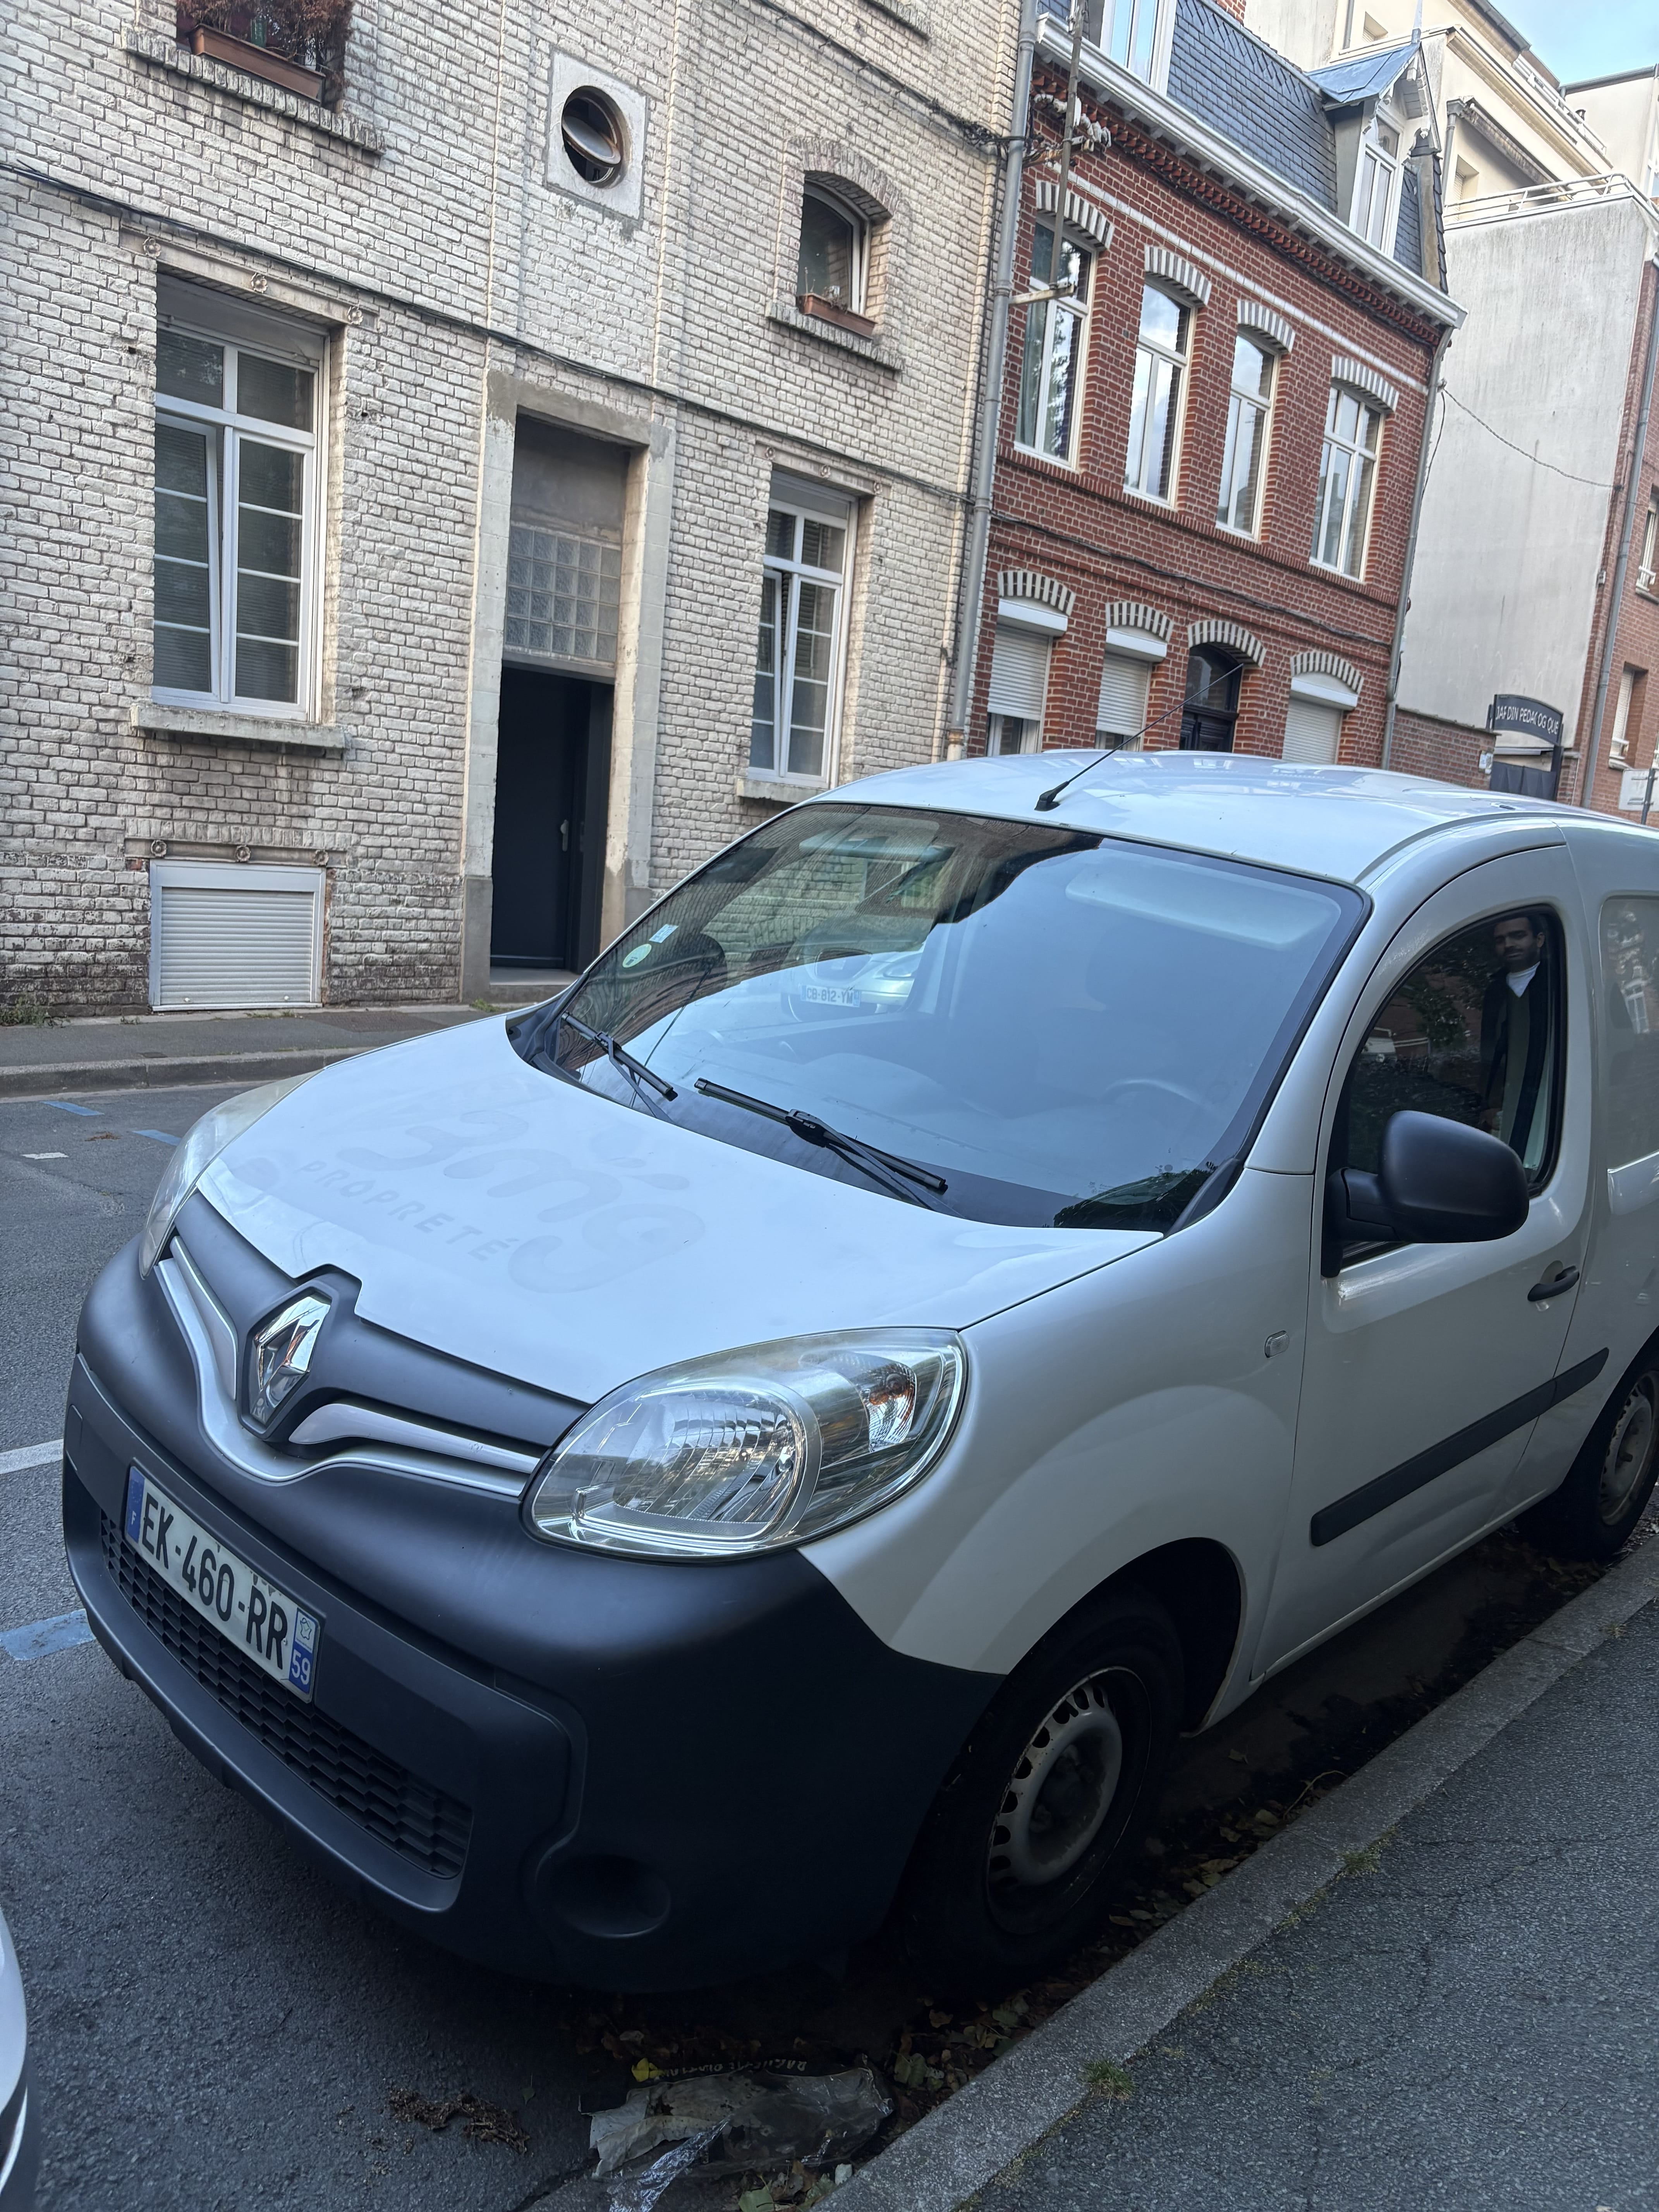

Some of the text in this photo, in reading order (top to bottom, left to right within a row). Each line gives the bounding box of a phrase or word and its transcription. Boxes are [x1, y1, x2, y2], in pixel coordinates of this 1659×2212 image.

[1519, 708, 1559, 735] PEDAOGQUE
[131, 1510, 137, 1525] F
[141, 1492, 288, 1670] EK-460-RR
[291, 1650, 310, 1685] 59
